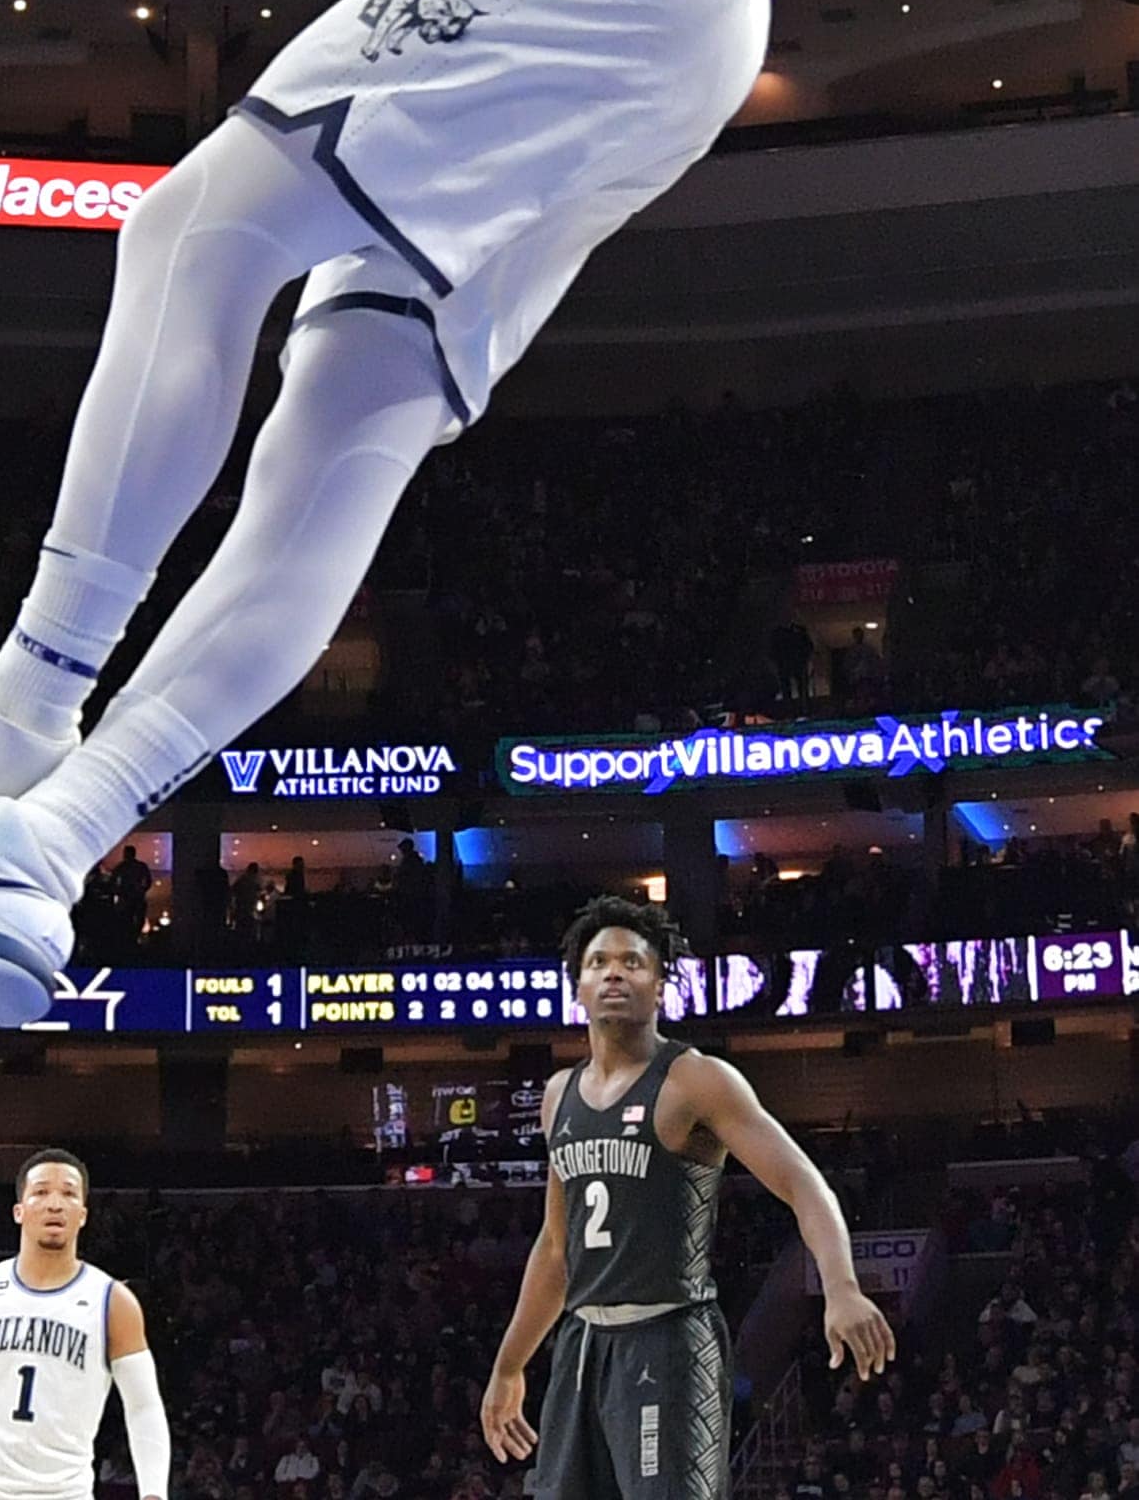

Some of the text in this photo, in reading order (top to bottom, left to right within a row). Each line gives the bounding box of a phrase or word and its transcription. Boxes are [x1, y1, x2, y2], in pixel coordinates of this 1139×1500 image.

[269, 746, 456, 775] VILLANOVA
[273, 775, 441, 796] ATHLETIC FUND
[195, 973, 282, 997] FOULS 1
[307, 973, 394, 993] PLAYER
[206, 1001, 282, 1025] TOL 1
[311, 1002, 395, 1021] POINTS
[549, 1138, 652, 1183] GEORGETOWN
[585, 1180, 612, 1249] 2
[12, 1364, 37, 1422] 1
